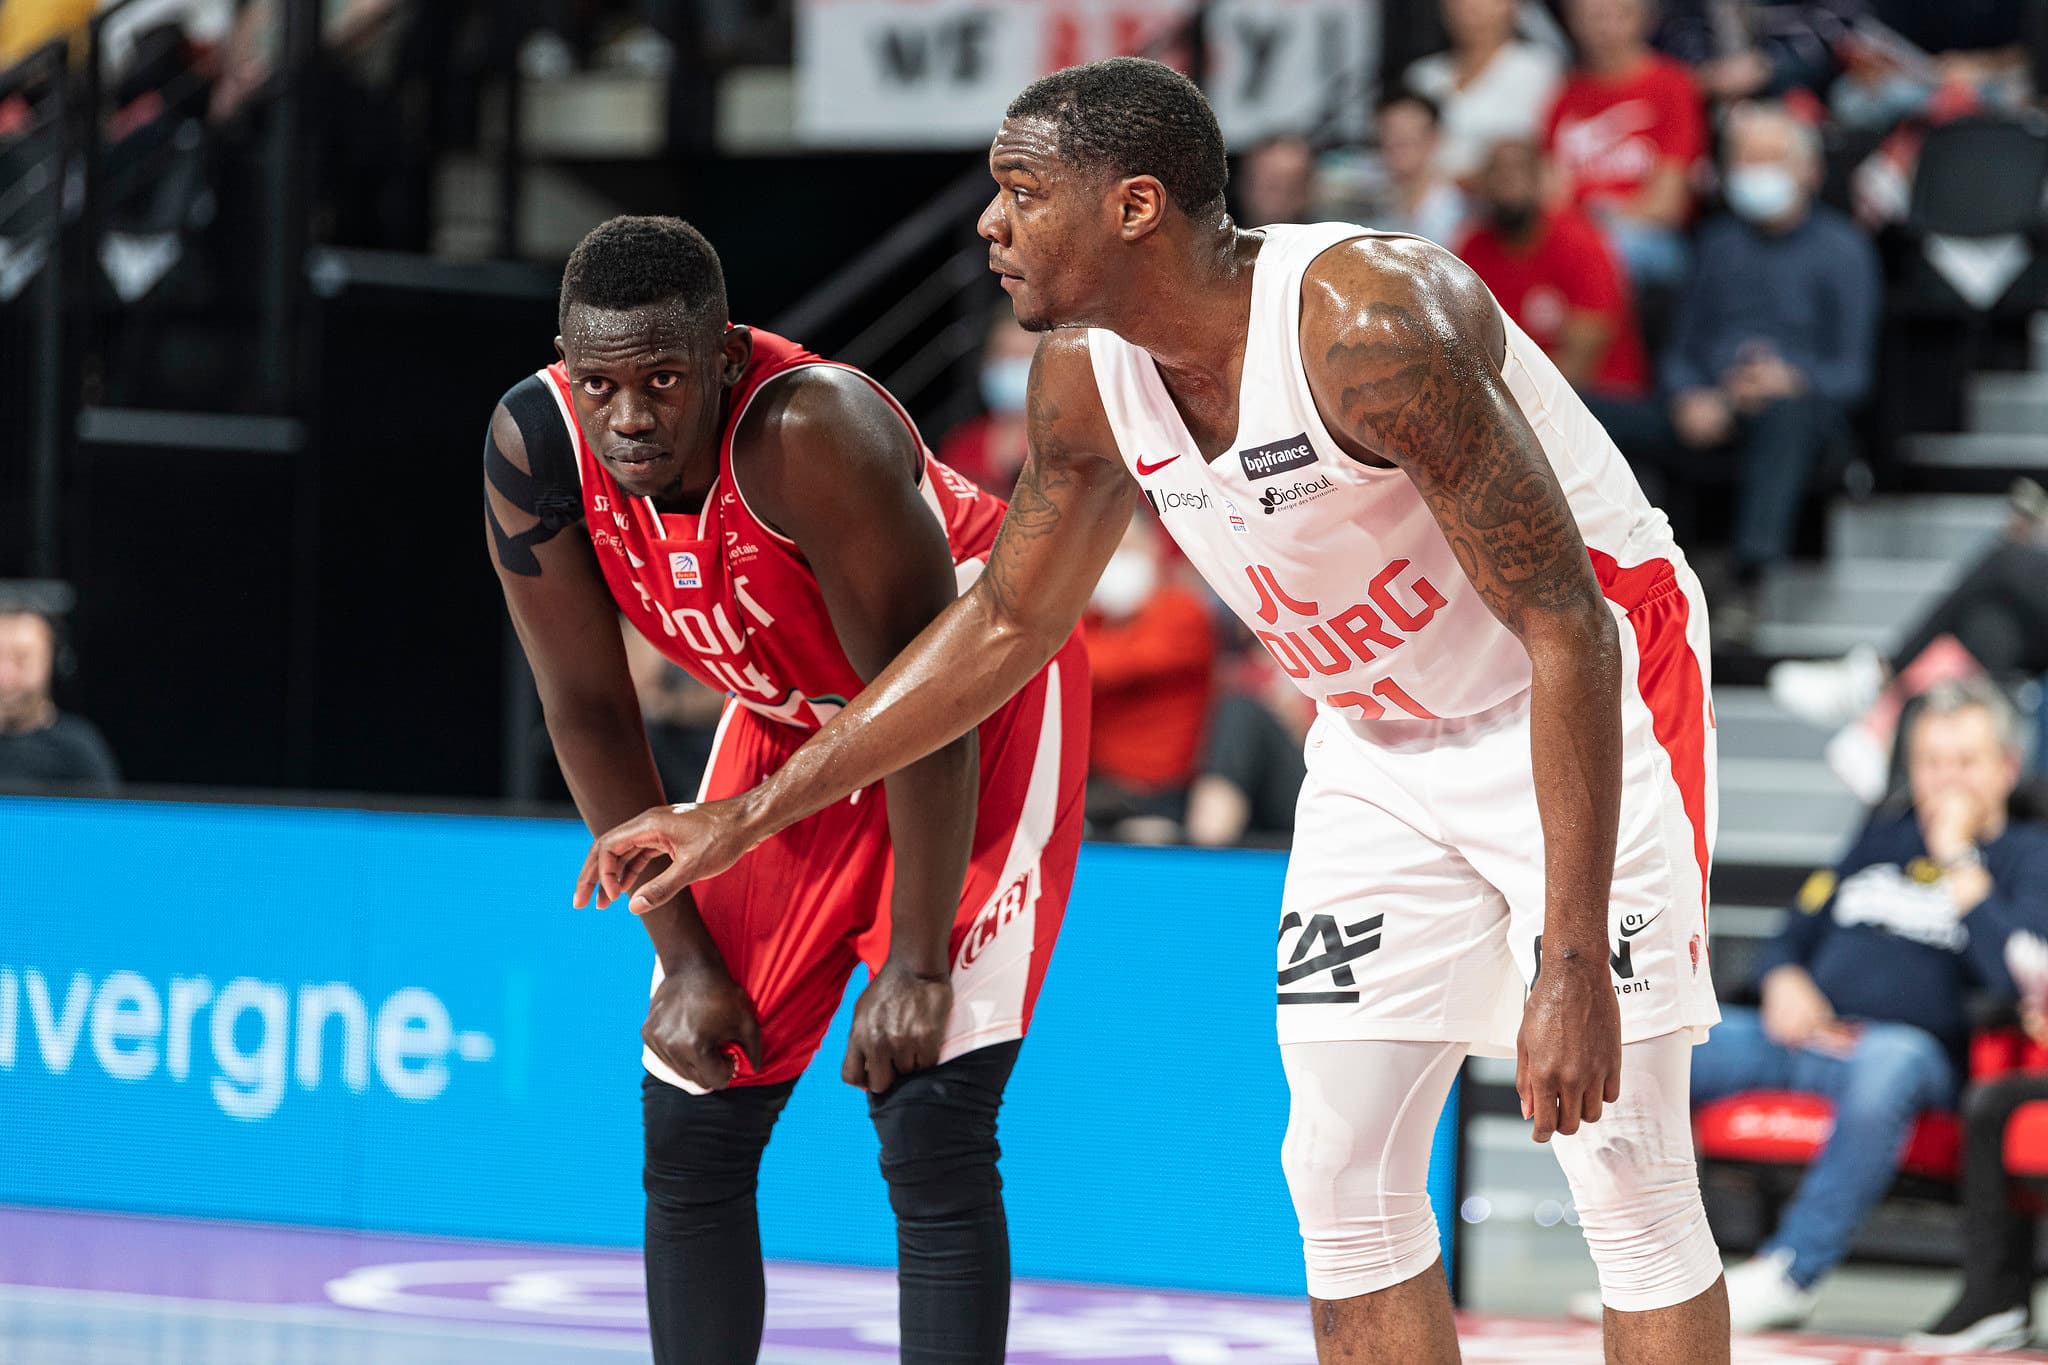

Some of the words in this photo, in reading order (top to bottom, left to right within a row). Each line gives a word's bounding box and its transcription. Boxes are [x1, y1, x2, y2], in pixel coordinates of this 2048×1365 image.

[1244, 444, 1310, 473] bpifrance
[1265, 474, 1334, 506] Biofioul
[729, 543, 759, 559] etais
[1245, 564, 1319, 626] JL
[1255, 558, 1449, 679] OURG
[1626, 913, 1644, 926] 01
